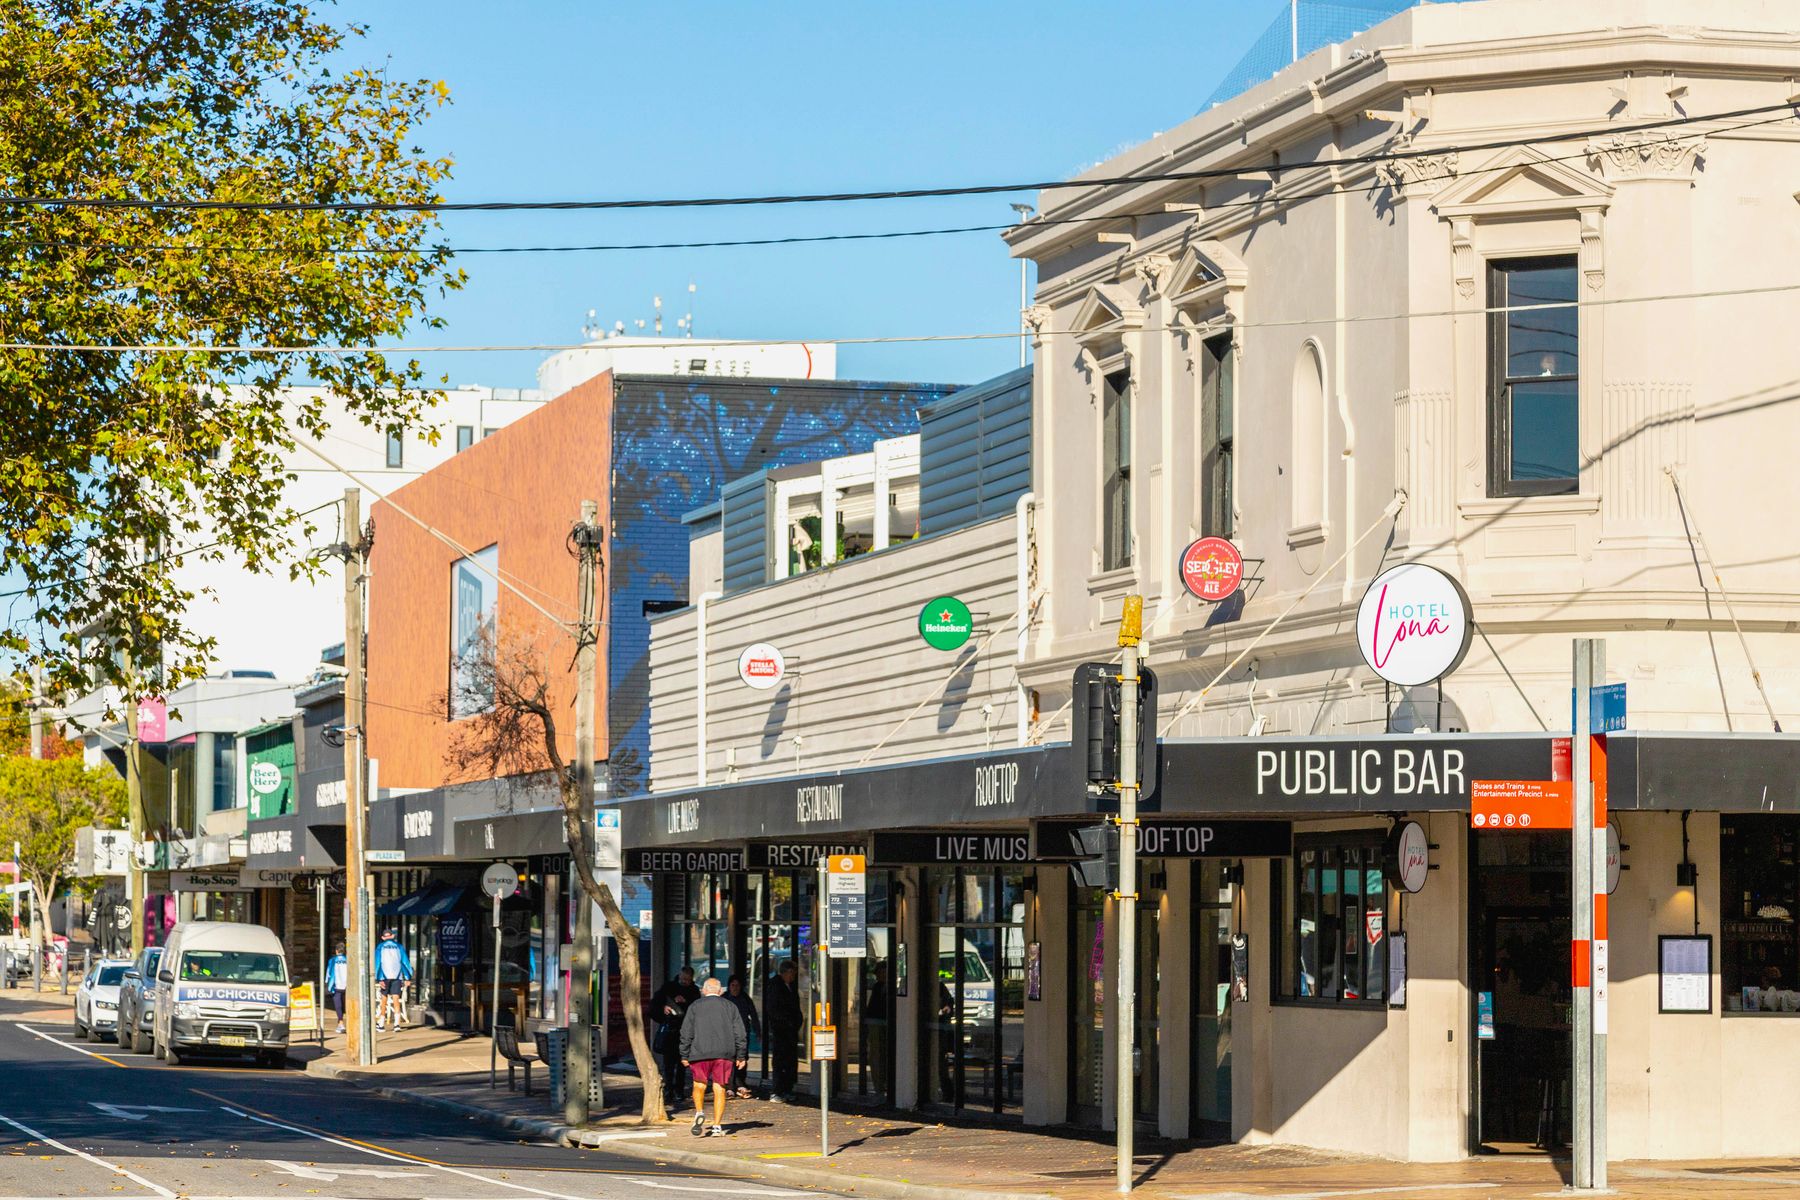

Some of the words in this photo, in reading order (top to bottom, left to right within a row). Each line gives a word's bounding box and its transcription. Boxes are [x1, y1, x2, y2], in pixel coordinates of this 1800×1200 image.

[1186, 559, 1239, 576] SEDGLEY
[1203, 583, 1219, 593] ALE
[1389, 603, 1449, 619] HOTEL
[925, 623, 967, 632] Heineken
[1373, 583, 1449, 669] Lona
[254, 769, 277, 777] Beer
[1257, 749, 1382, 795] PUBLIC
[1393, 749, 1465, 794] BAR
[254, 777, 278, 786] Here
[976, 762, 1019, 807] ROOFTOP
[1473, 782, 1492, 790] Buses
[1493, 782, 1505, 790] and
[1506, 782, 1525, 790] Trains
[1517, 790, 1543, 798] Precinct
[797, 784, 844, 823] RESTAURANT
[667, 802, 682, 834] LIVE
[681, 799, 700, 832] MUSIC
[1134, 827, 1214, 853] OOFTOP
[936, 837, 977, 860] LIVE
[984, 838, 1027, 861] MUS
[641, 852, 682, 870] BEER
[189, 876, 210, 885] Hop
[211, 876, 238, 885] Shop
[187, 988, 214, 999] M&J
[216, 988, 281, 1003] CHICKENS
